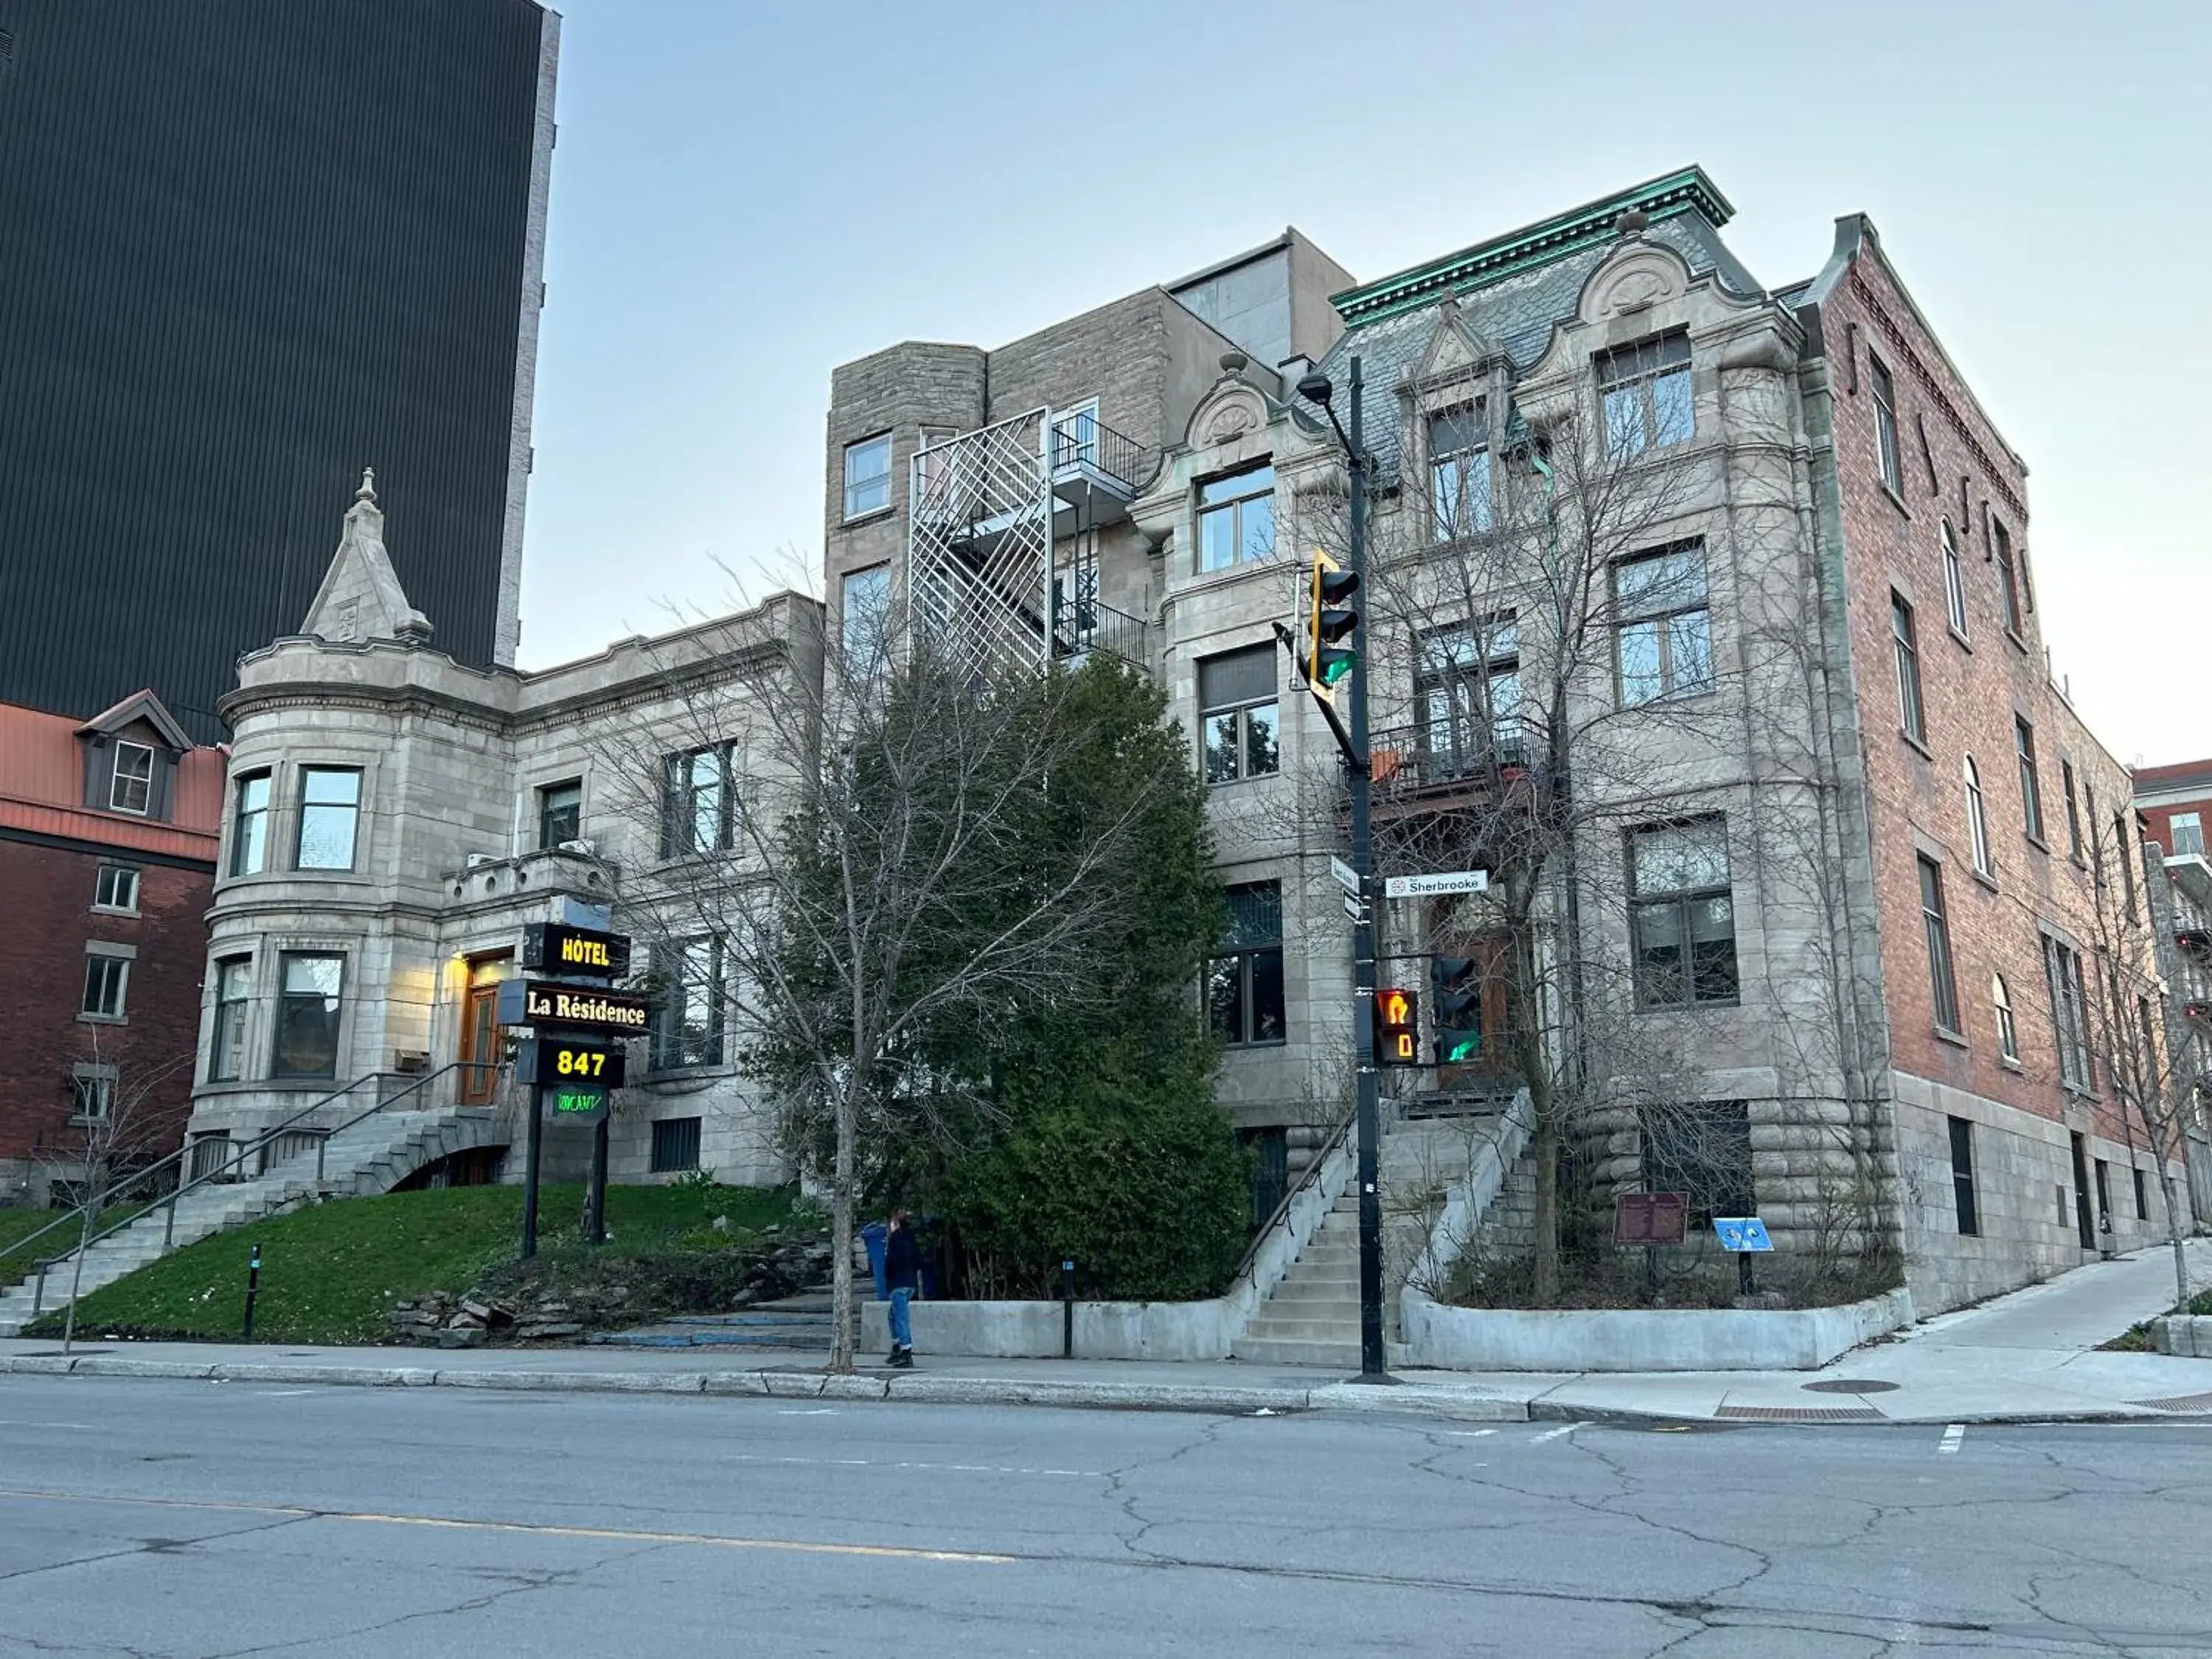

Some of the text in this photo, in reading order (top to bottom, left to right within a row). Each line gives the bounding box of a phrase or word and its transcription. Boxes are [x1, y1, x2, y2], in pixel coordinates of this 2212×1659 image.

[1409, 879, 1478, 893] Sherbrooke
[561, 933, 610, 967] HÔTEL
[527, 991, 645, 1024] La Résidence
[557, 1050, 605, 1076] 847
